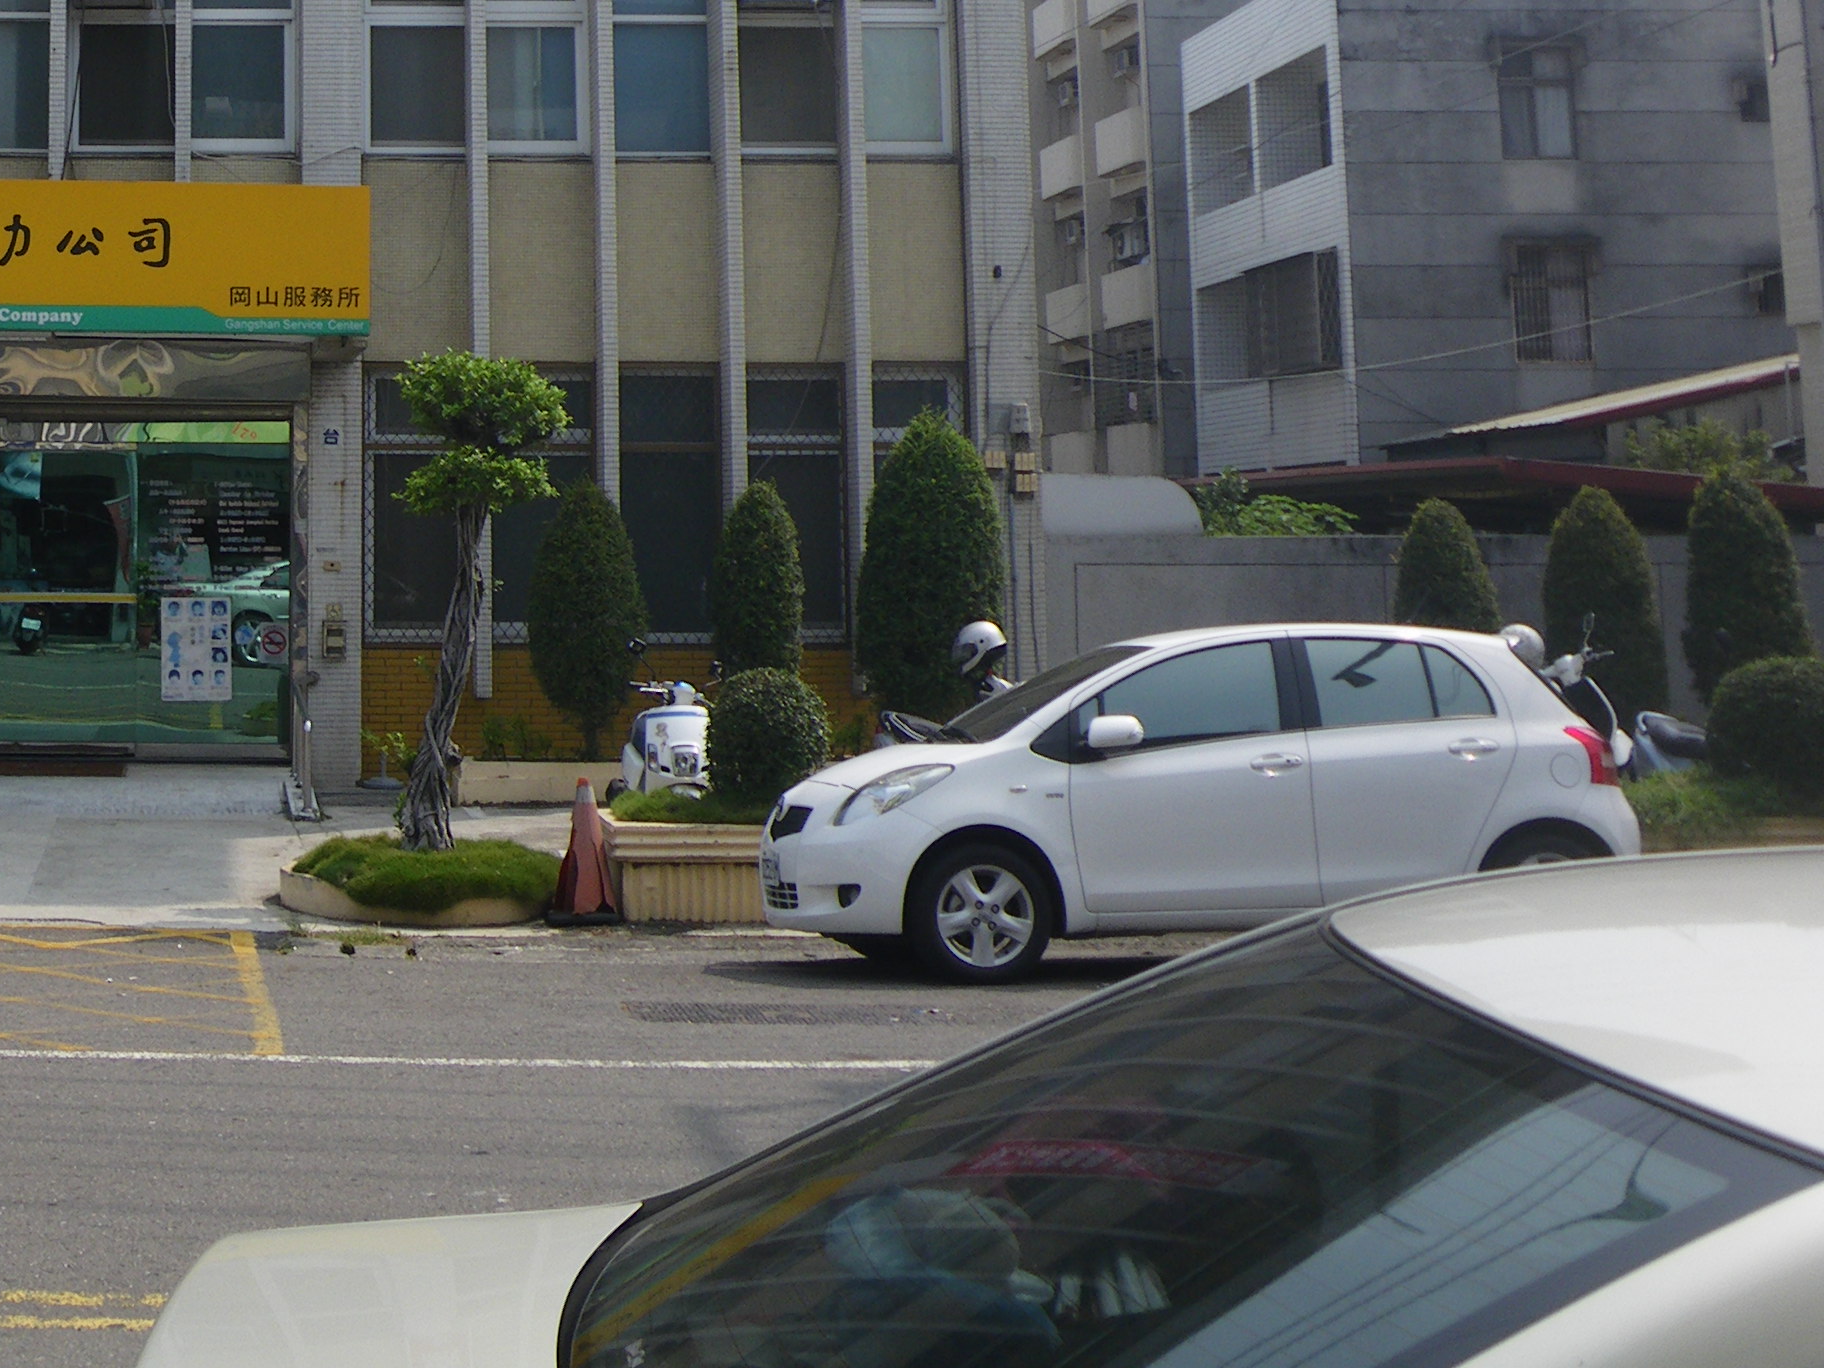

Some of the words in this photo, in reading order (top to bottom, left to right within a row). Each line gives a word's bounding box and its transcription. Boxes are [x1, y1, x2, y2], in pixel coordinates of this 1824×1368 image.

[229, 286, 361, 309] 岡山服務所
[224, 318, 281, 332] Gangshan
[282, 319, 324, 331] Service
[327, 319, 365, 331] Center
